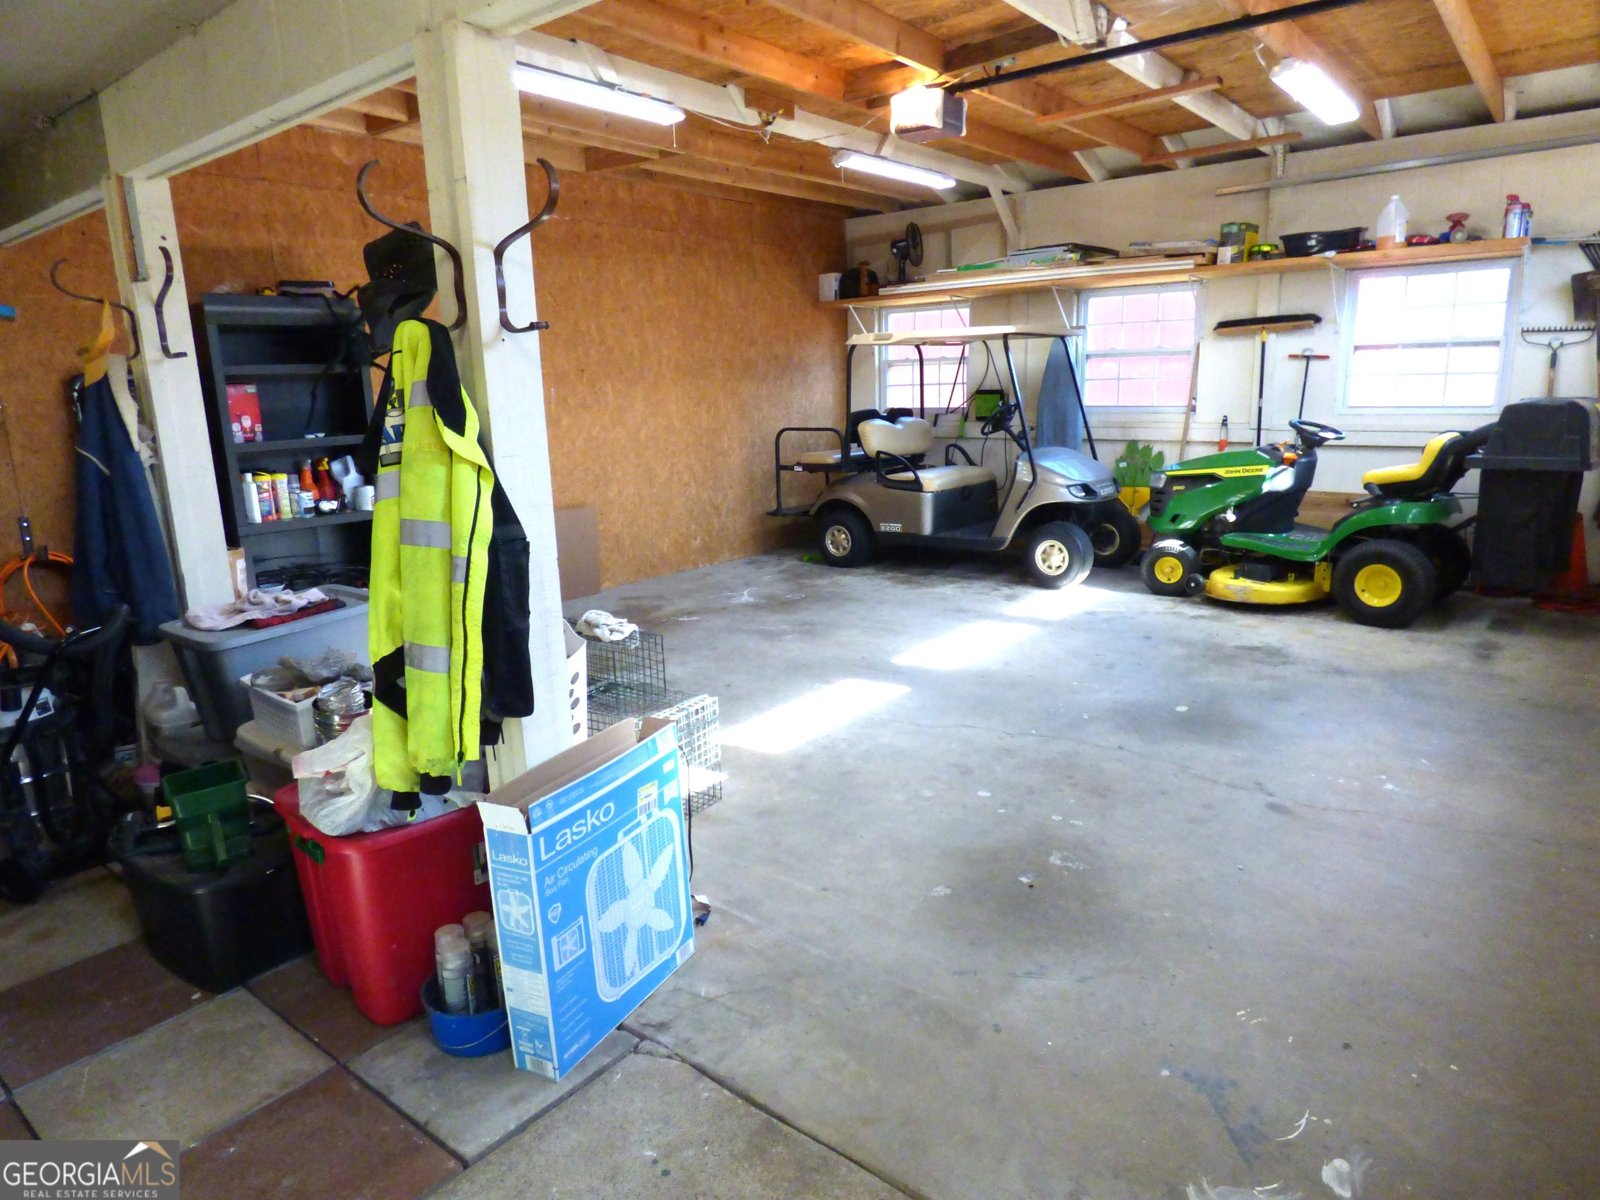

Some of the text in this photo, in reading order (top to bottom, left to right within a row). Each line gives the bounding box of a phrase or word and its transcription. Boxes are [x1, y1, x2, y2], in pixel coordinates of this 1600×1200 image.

[539, 801, 616, 862] Lasko
[491, 850, 528, 867] Lasko
[544, 873, 556, 888] Air
[557, 846, 599, 879] Circulating
